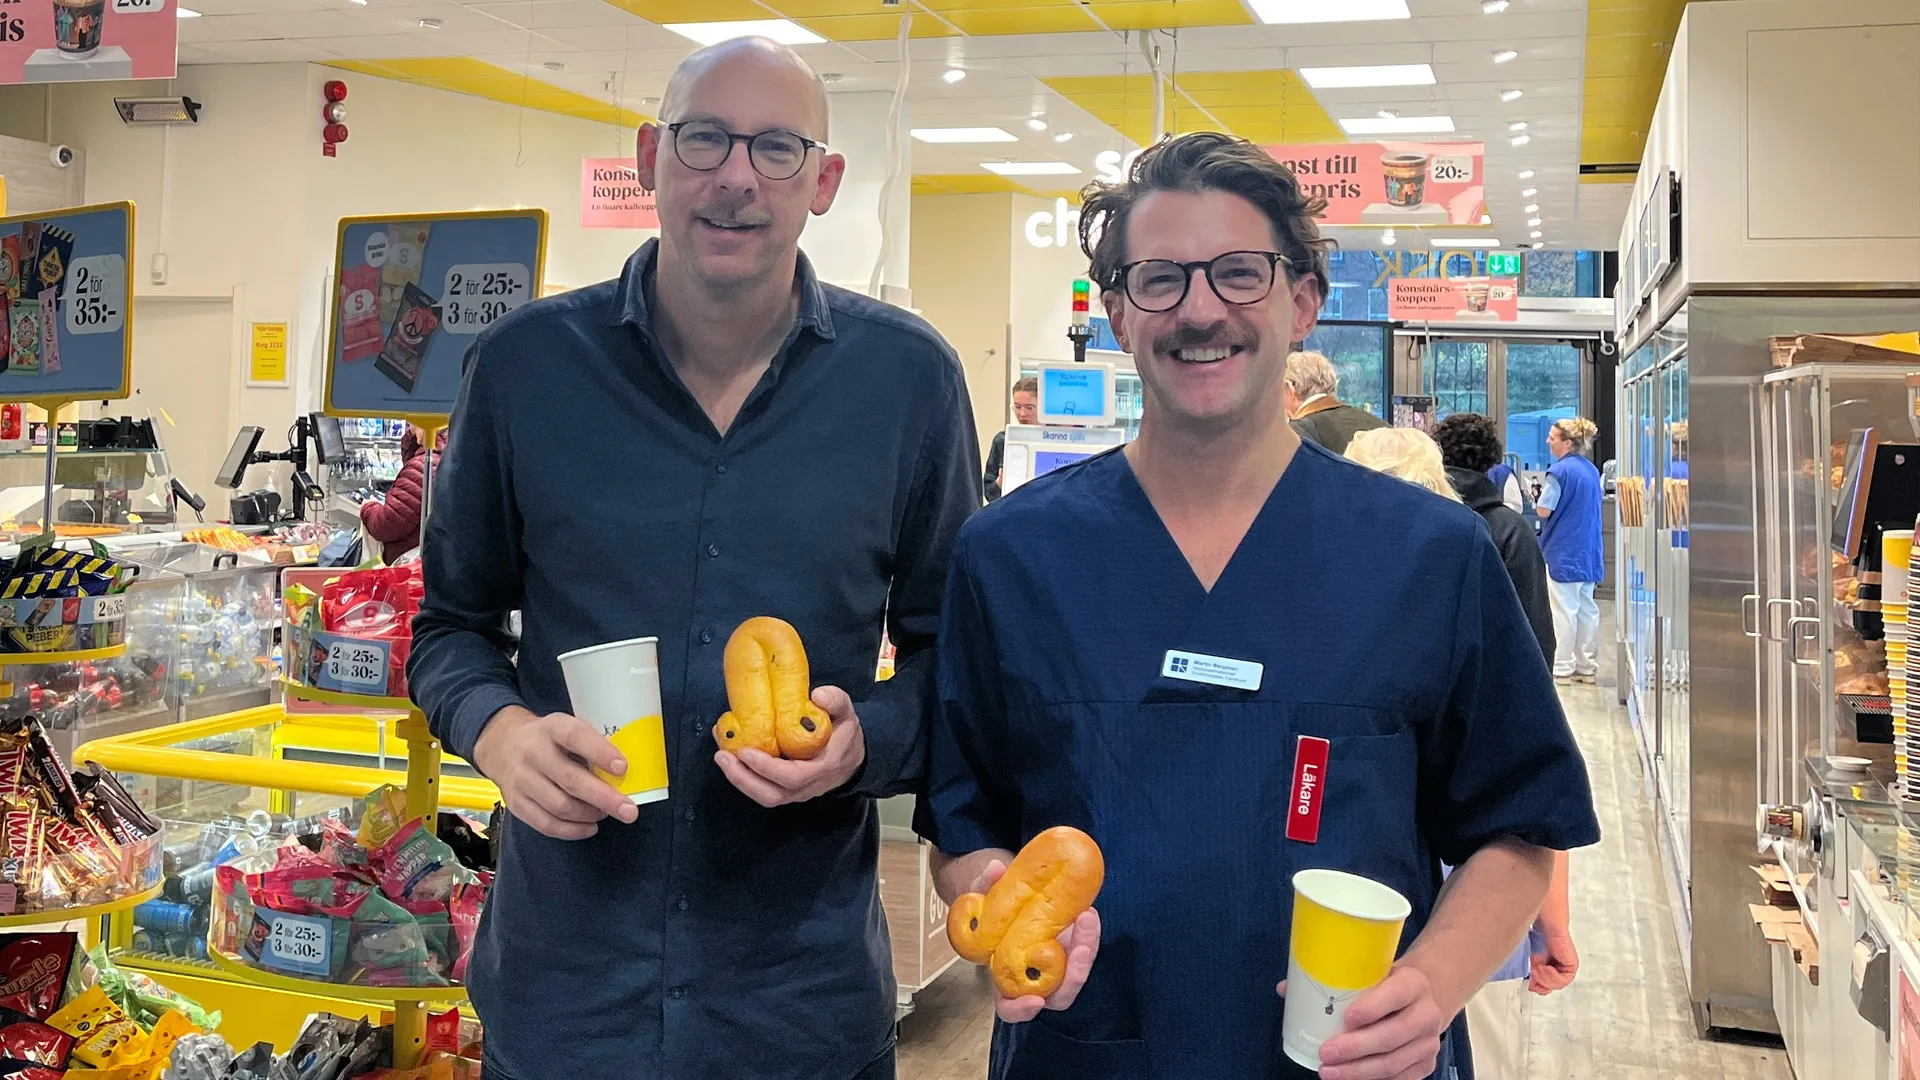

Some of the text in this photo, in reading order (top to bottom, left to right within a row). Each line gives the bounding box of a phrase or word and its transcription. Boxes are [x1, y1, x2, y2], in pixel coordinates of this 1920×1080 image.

[1325, 155, 1358, 175] till
[1435, 165, 1470, 179] 20:-
[76, 267, 89, 294] 2
[90, 277, 103, 293] för
[450, 272, 522, 296] 2 för 25:-
[1396, 294, 1436, 303] koppen
[75, 298, 116, 326] 35:-
[448, 303, 460, 325] 3
[464, 308, 478, 324] för
[1042, 430, 1068, 441] Skanna
[98, 601, 106, 617] 2
[26, 630, 61, 644] PEBER
[332, 646, 379, 664] 2 för 25:-
[331, 661, 379, 680] 3 för 30:-
[1298, 763, 1318, 815] Läkare
[275, 922, 283, 935] 2
[295, 925, 322, 942] 25:-
[274, 938, 282, 952] 3
[294, 942, 322, 958] 30:-
[1, 953, 61, 996] umle
